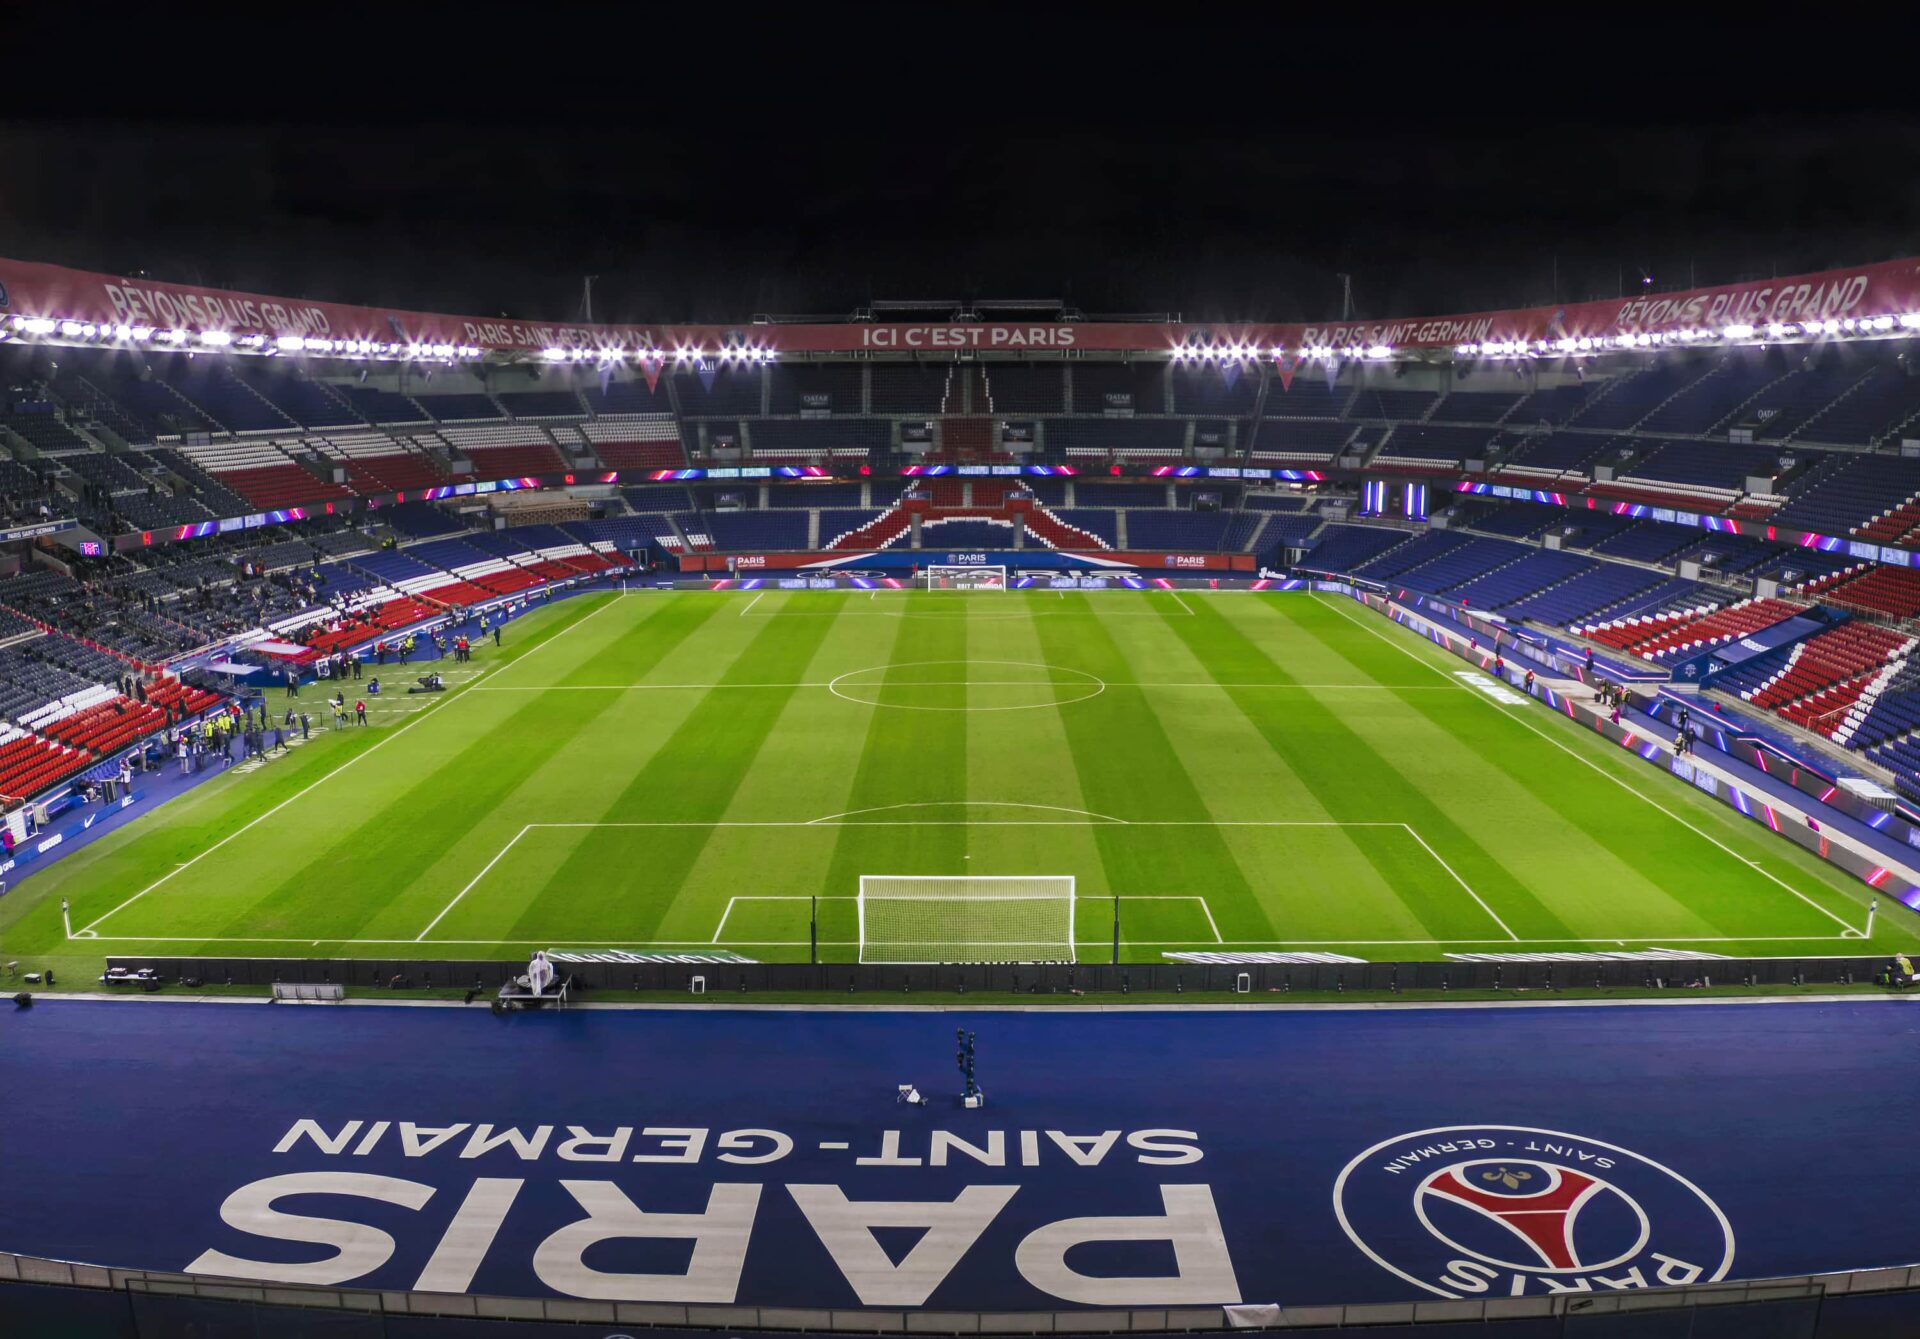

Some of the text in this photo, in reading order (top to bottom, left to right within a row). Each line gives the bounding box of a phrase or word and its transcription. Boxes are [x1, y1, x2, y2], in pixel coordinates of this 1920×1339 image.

[104, 279, 330, 334] RÊVONS PLUS GRAND
[1707, 288, 1772, 321] PLUS
[1768, 276, 1868, 318] GRAND
[464, 323, 512, 345] PARIS
[863, 328, 1075, 346] ICI C'EST PARIS
[1302, 318, 1493, 346] PARIS SAINT-GERMAIN
[1177, 556, 1205, 564] PARIS
[183, 1171, 1243, 1306] PARIS
